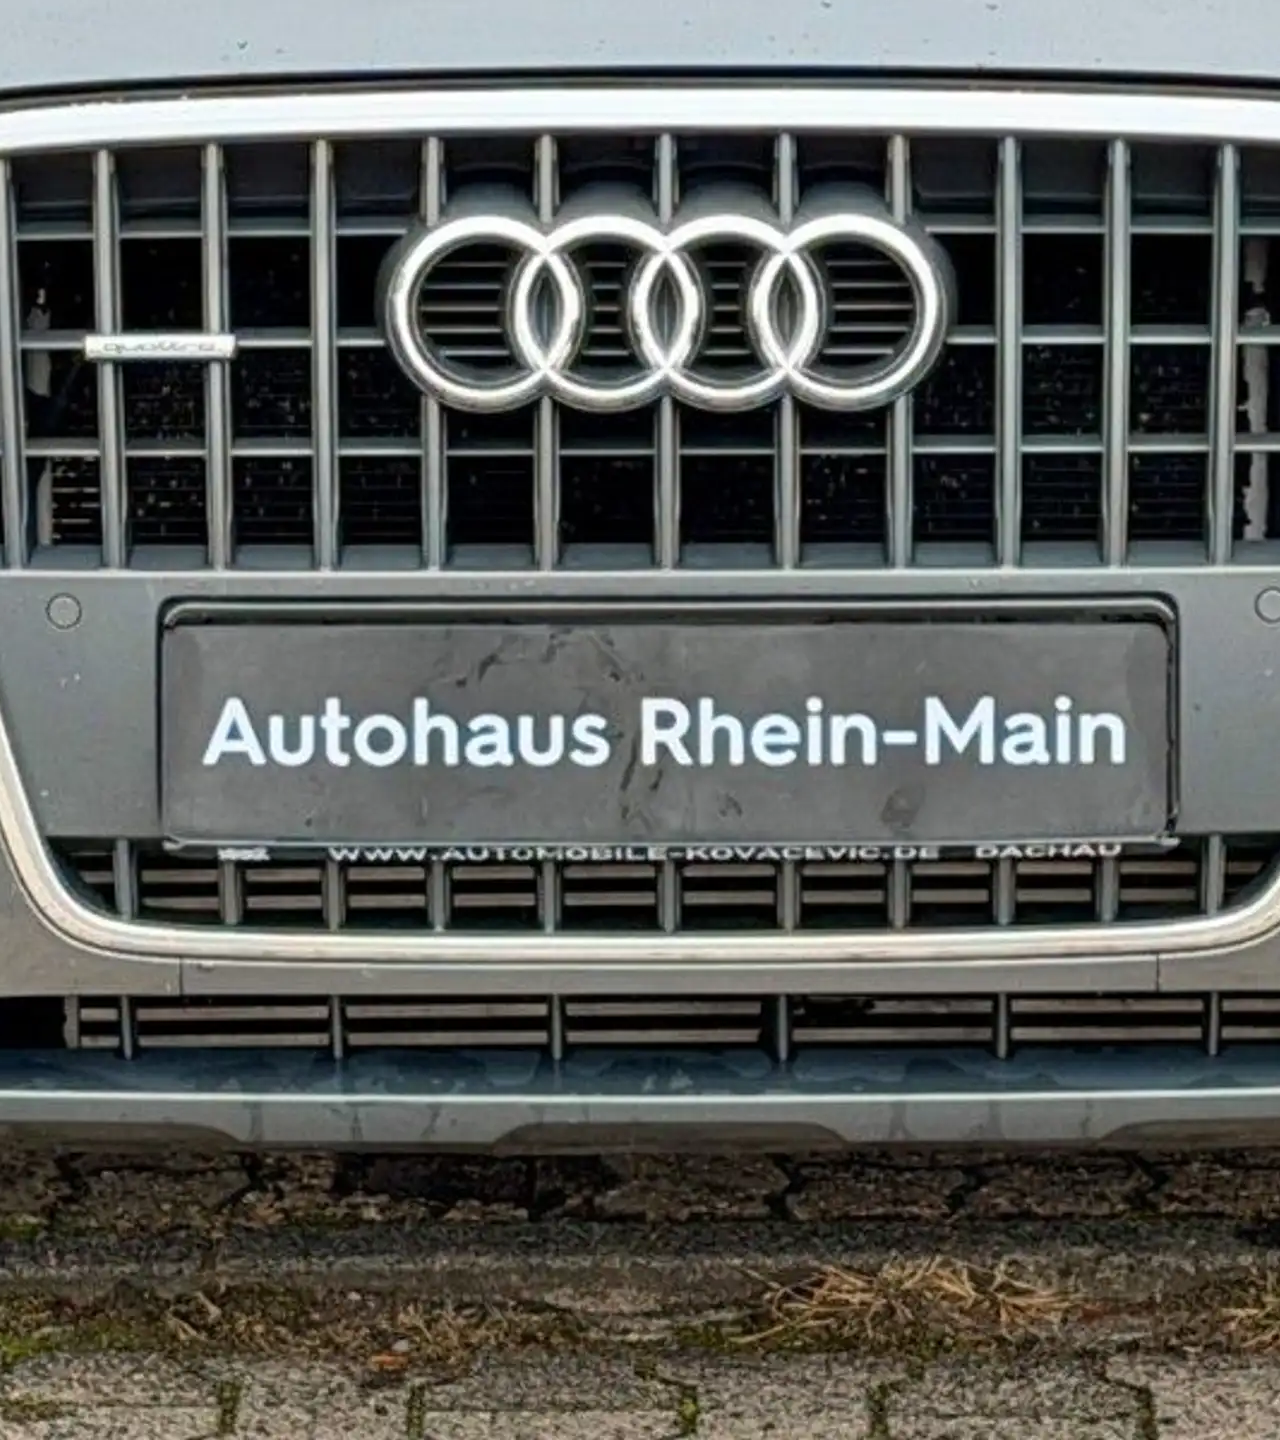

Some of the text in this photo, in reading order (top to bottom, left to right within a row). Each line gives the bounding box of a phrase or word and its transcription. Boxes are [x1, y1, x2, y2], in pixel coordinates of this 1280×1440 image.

[202, 696, 1126, 766] Autohaus Rhein-Main
[975, 844, 1122, 859] DACHAU
